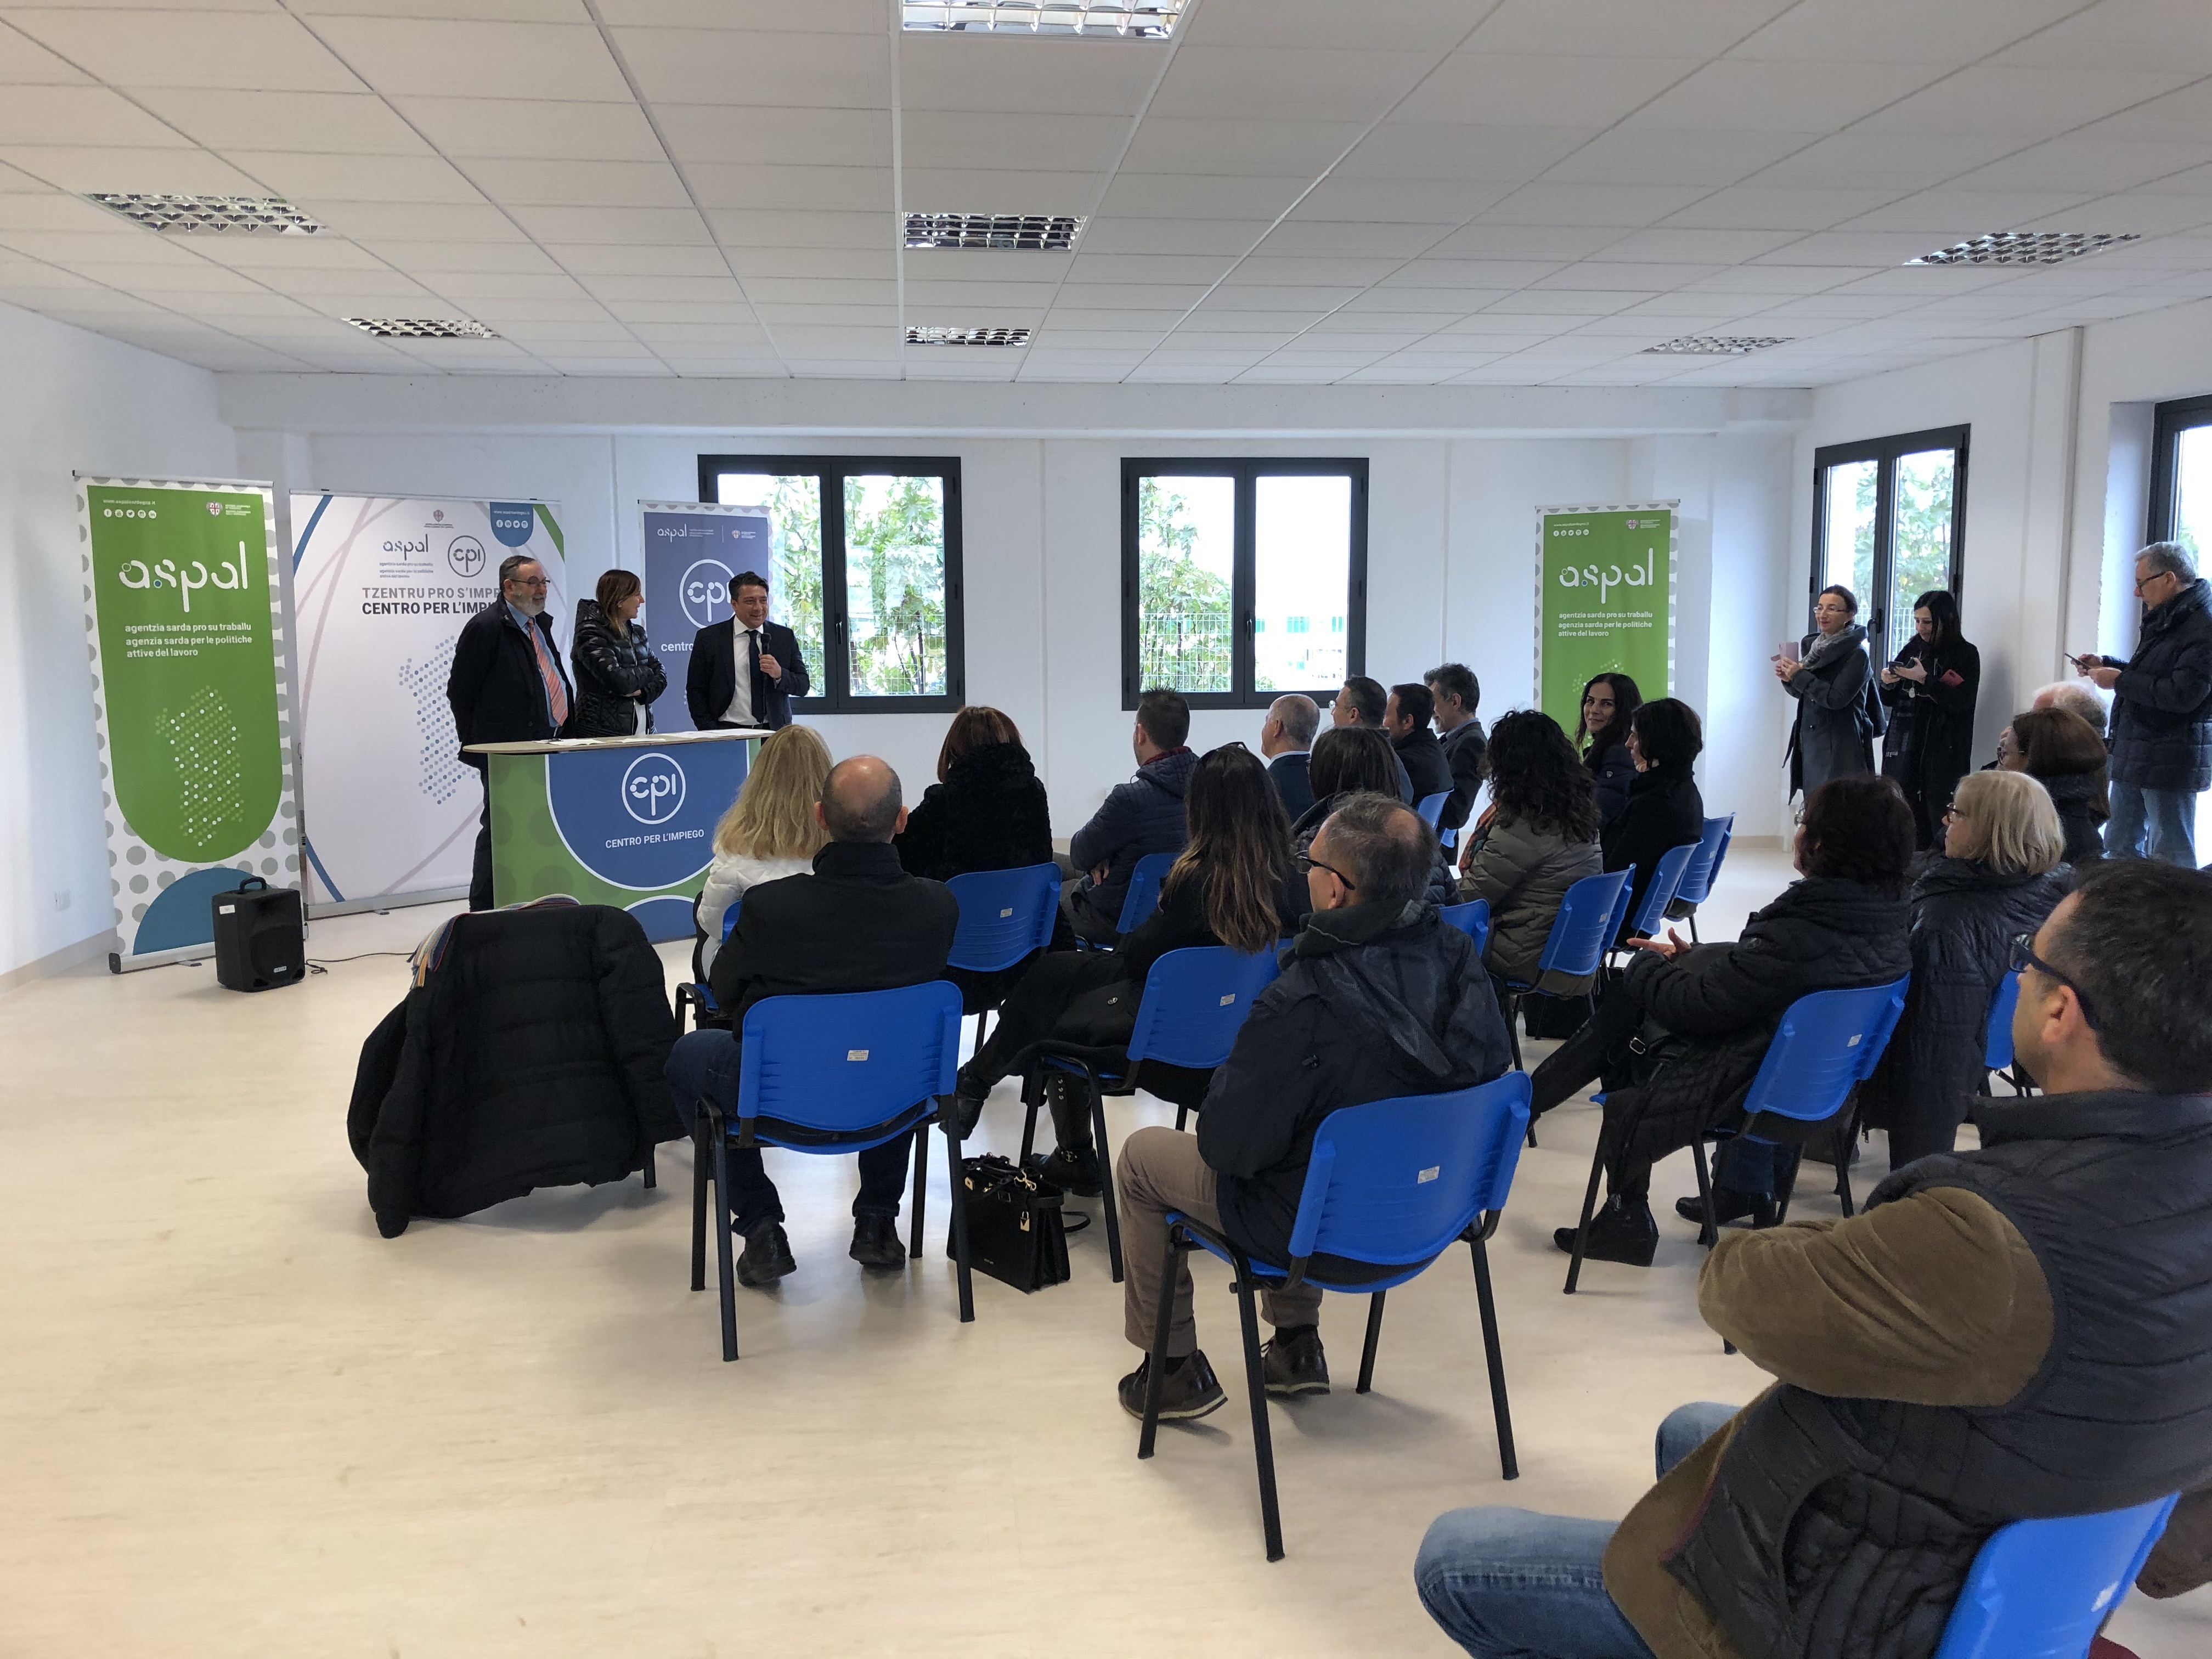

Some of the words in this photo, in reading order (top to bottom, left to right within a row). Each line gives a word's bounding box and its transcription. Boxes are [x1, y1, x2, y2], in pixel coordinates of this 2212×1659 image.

[657, 523, 687, 543] aspal
[383, 533, 428, 561] aspal
[119, 540, 248, 613] aspal
[1559, 548, 1653, 604] aspal
[362, 587, 425, 599] TZENTRU
[428, 587, 454, 598] PRO
[362, 602, 420, 614] CENTRO
[424, 602, 449, 614] PER
[125, 624, 165, 634] agentzia
[166, 623, 191, 631] sarda
[193, 624, 207, 633] pro
[219, 623, 251, 631] traballu
[126, 637, 162, 647] agenzia
[164, 636, 189, 645] sarda
[191, 637, 205, 646] per
[206, 636, 213, 644] le
[215, 635, 252, 645] politiche
[127, 649, 154, 658] attive
[155, 648, 169, 657] del
[170, 648, 198, 656] lavoro
[605, 837, 641, 848] CENTRO
[644, 834, 661, 844] PER
[663, 829, 704, 842] L'IMPIEGO
